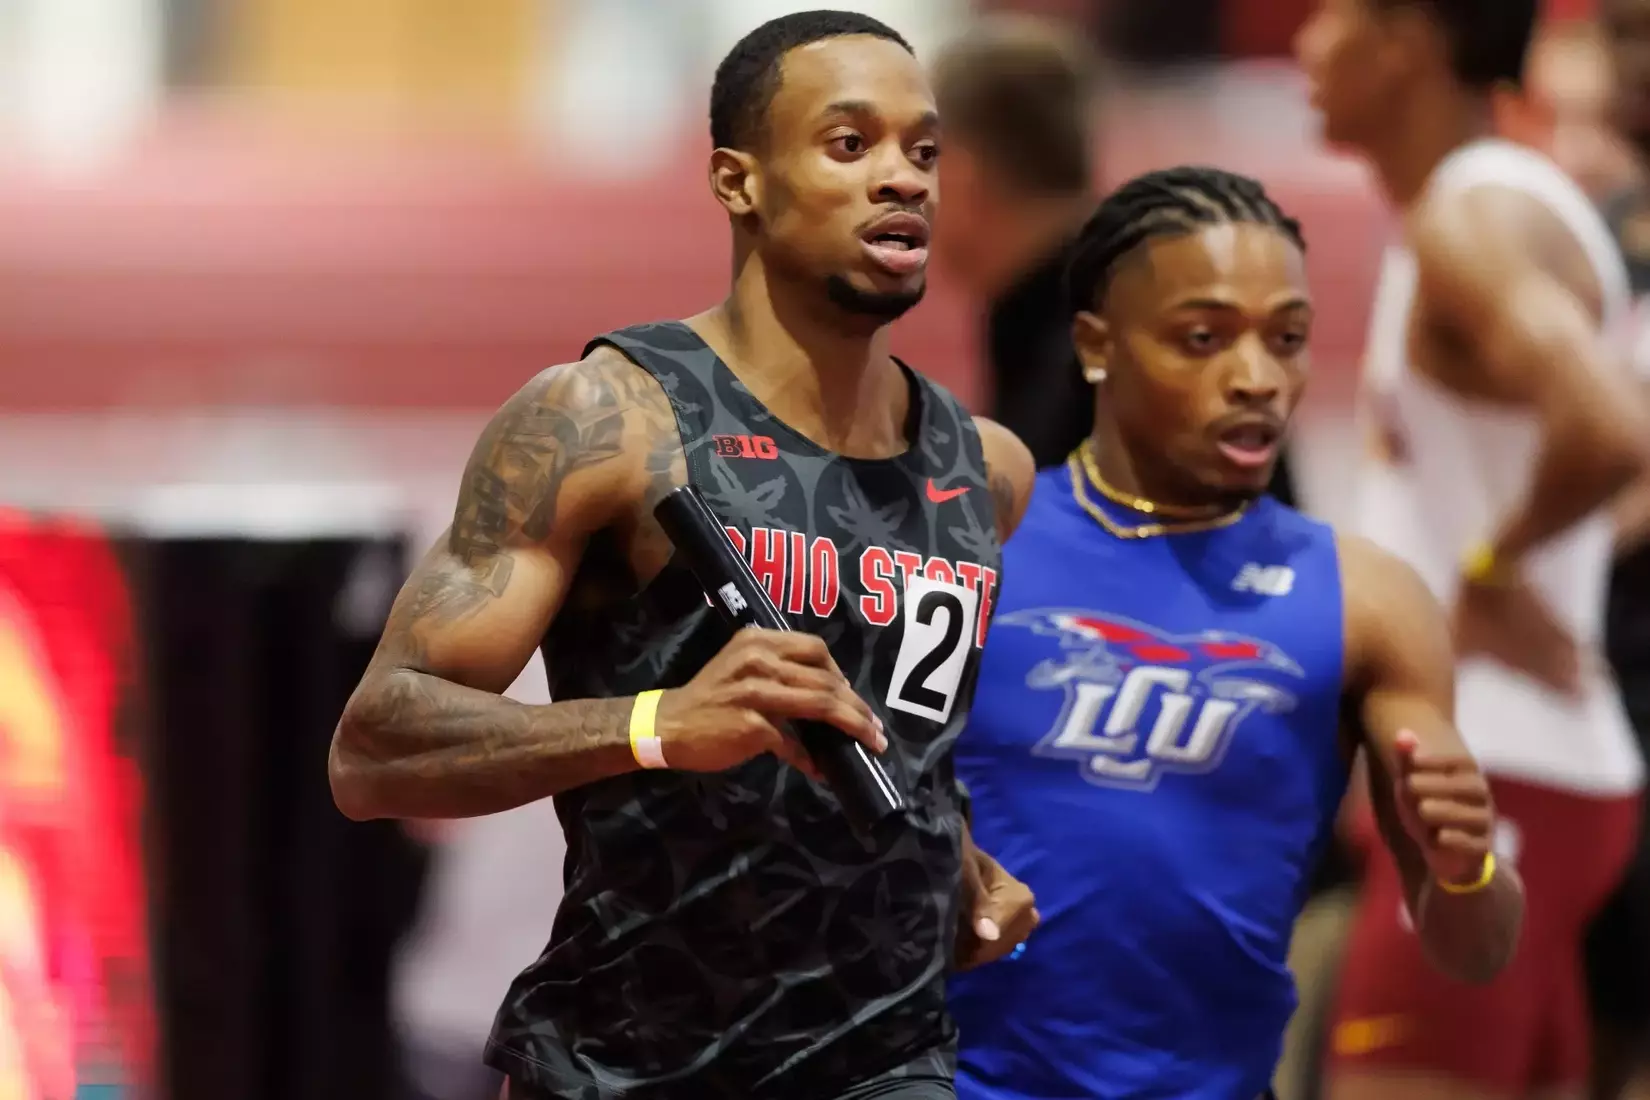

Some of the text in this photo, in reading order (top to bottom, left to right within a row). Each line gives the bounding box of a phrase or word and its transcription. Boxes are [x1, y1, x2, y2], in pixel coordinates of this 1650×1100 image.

[704, 526, 840, 618] HIO
[898, 590, 964, 713] 2
[1053, 665, 1238, 780] LCU
